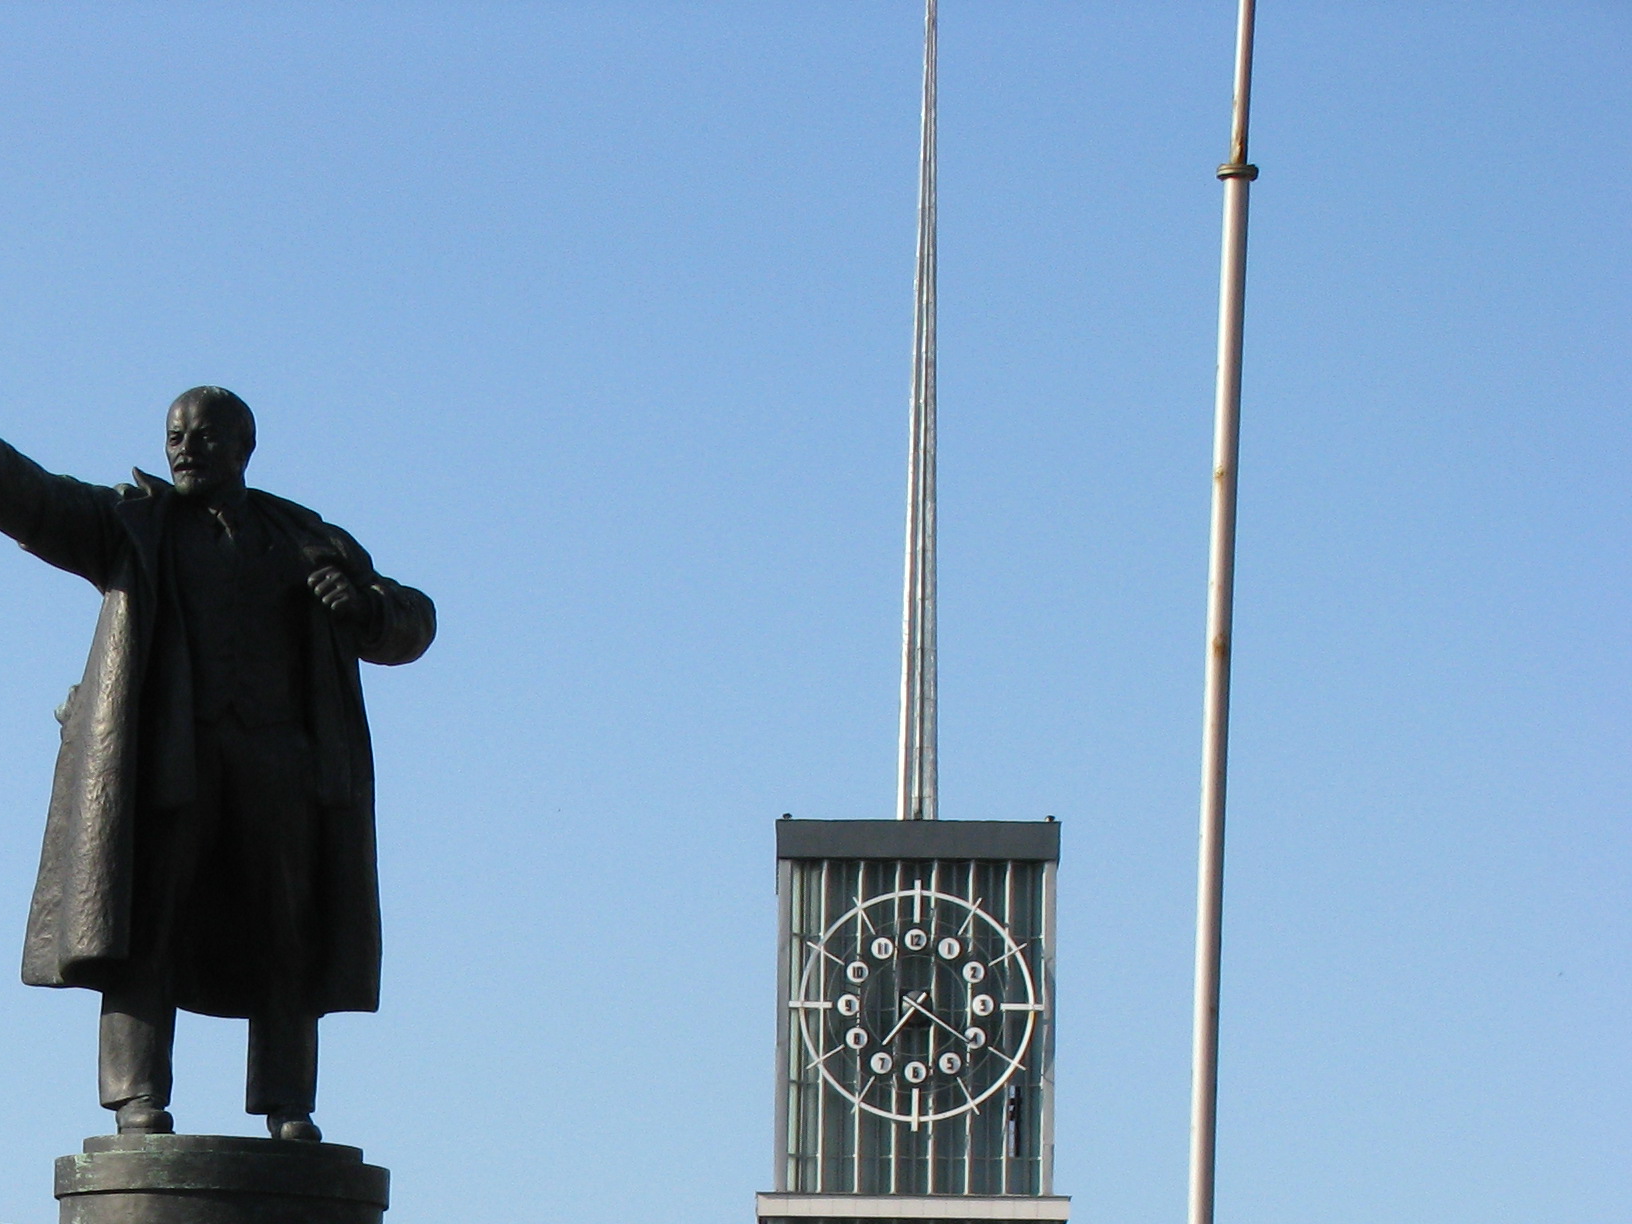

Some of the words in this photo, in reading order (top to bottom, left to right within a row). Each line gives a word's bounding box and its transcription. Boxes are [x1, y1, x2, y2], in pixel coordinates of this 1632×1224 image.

[910, 933, 921, 947] 12
[877, 942, 888, 955] 11
[852, 966, 863, 978] 10
[970, 966, 977, 979] 2
[979, 999, 986, 1012] 3
[853, 1032, 860, 1045] 8
[878, 1057, 885, 1069] 7
[946, 1057, 954, 1070] 5
[911, 1066, 919, 1079] 6
